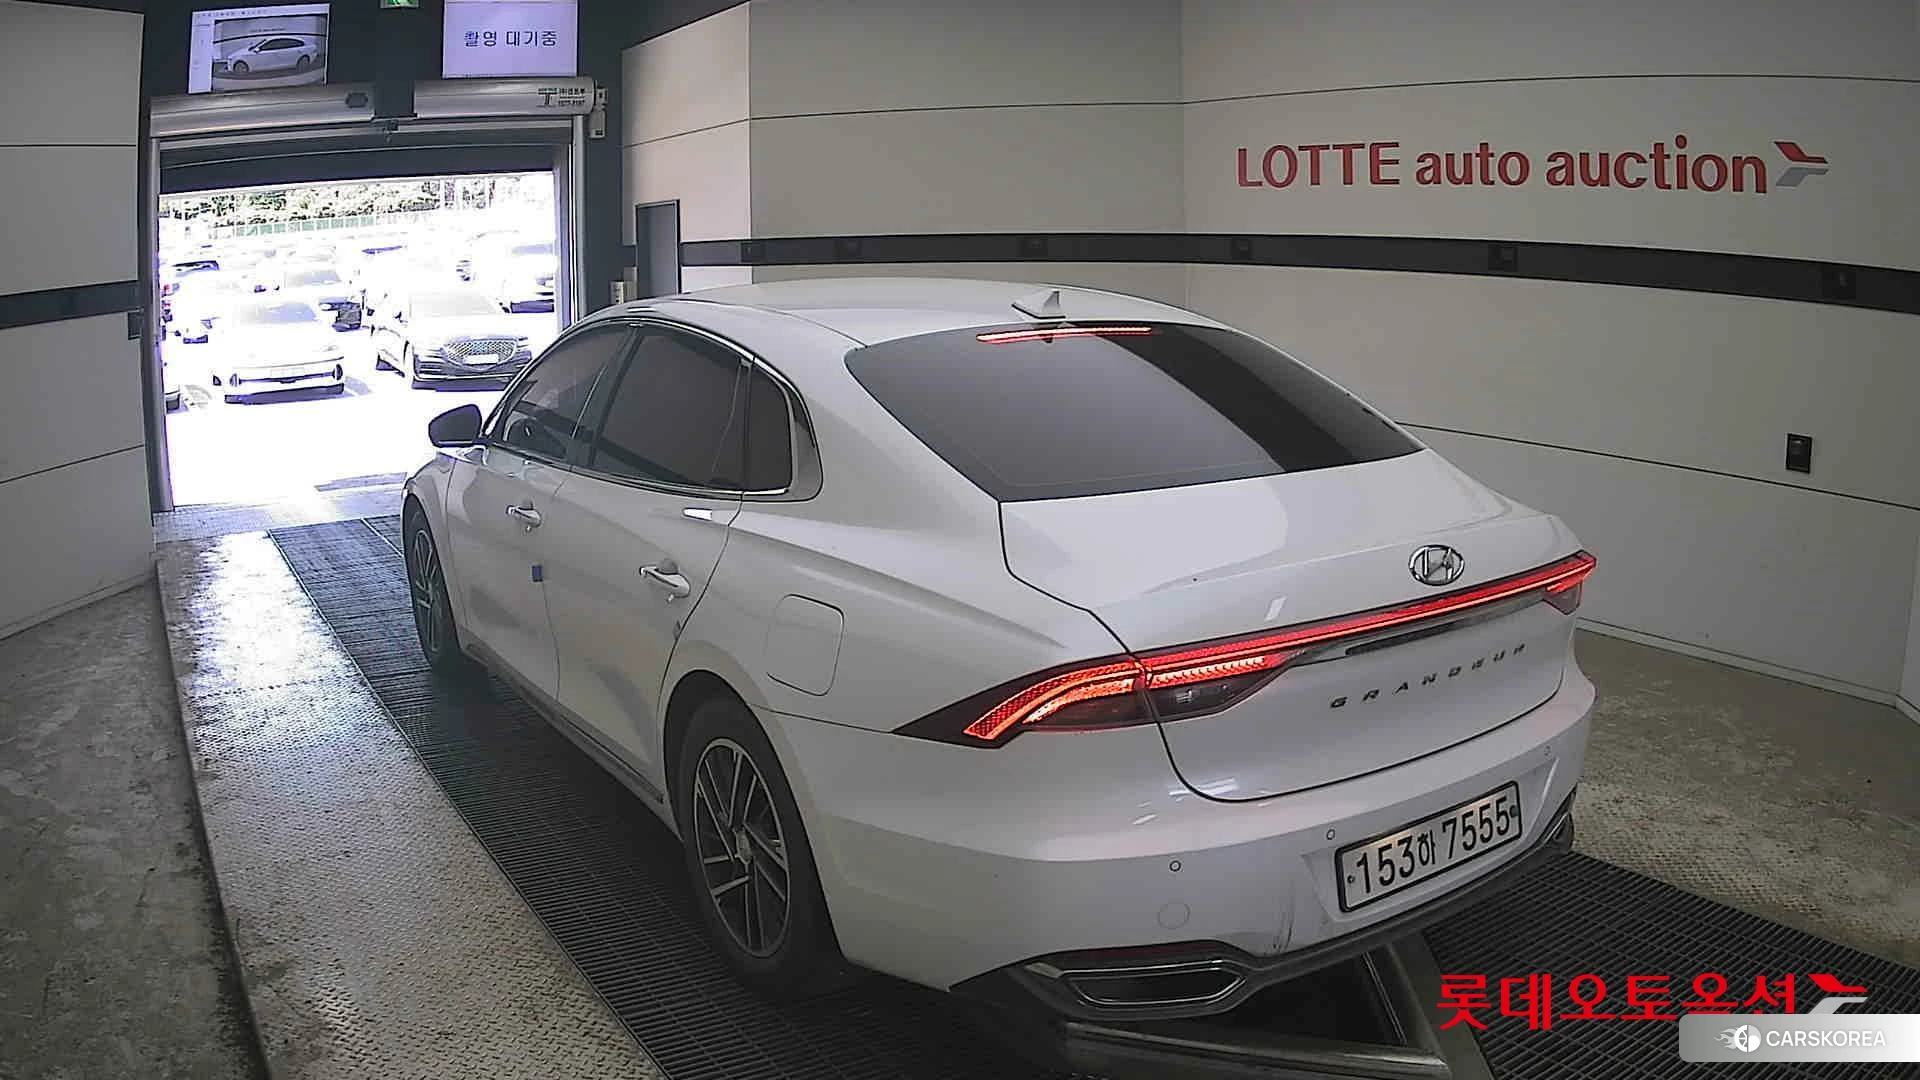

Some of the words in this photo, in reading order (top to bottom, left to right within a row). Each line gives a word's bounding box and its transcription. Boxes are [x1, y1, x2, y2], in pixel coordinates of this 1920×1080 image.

[506, 31, 557, 47] 대기중
[1238, 142, 1400, 188] LOTTE
[1415, 142, 1530, 186] auto
[1546, 135, 1767, 194] auction
[1356, 829, 1437, 894] 153하
[1442, 796, 1511, 859] 7555
